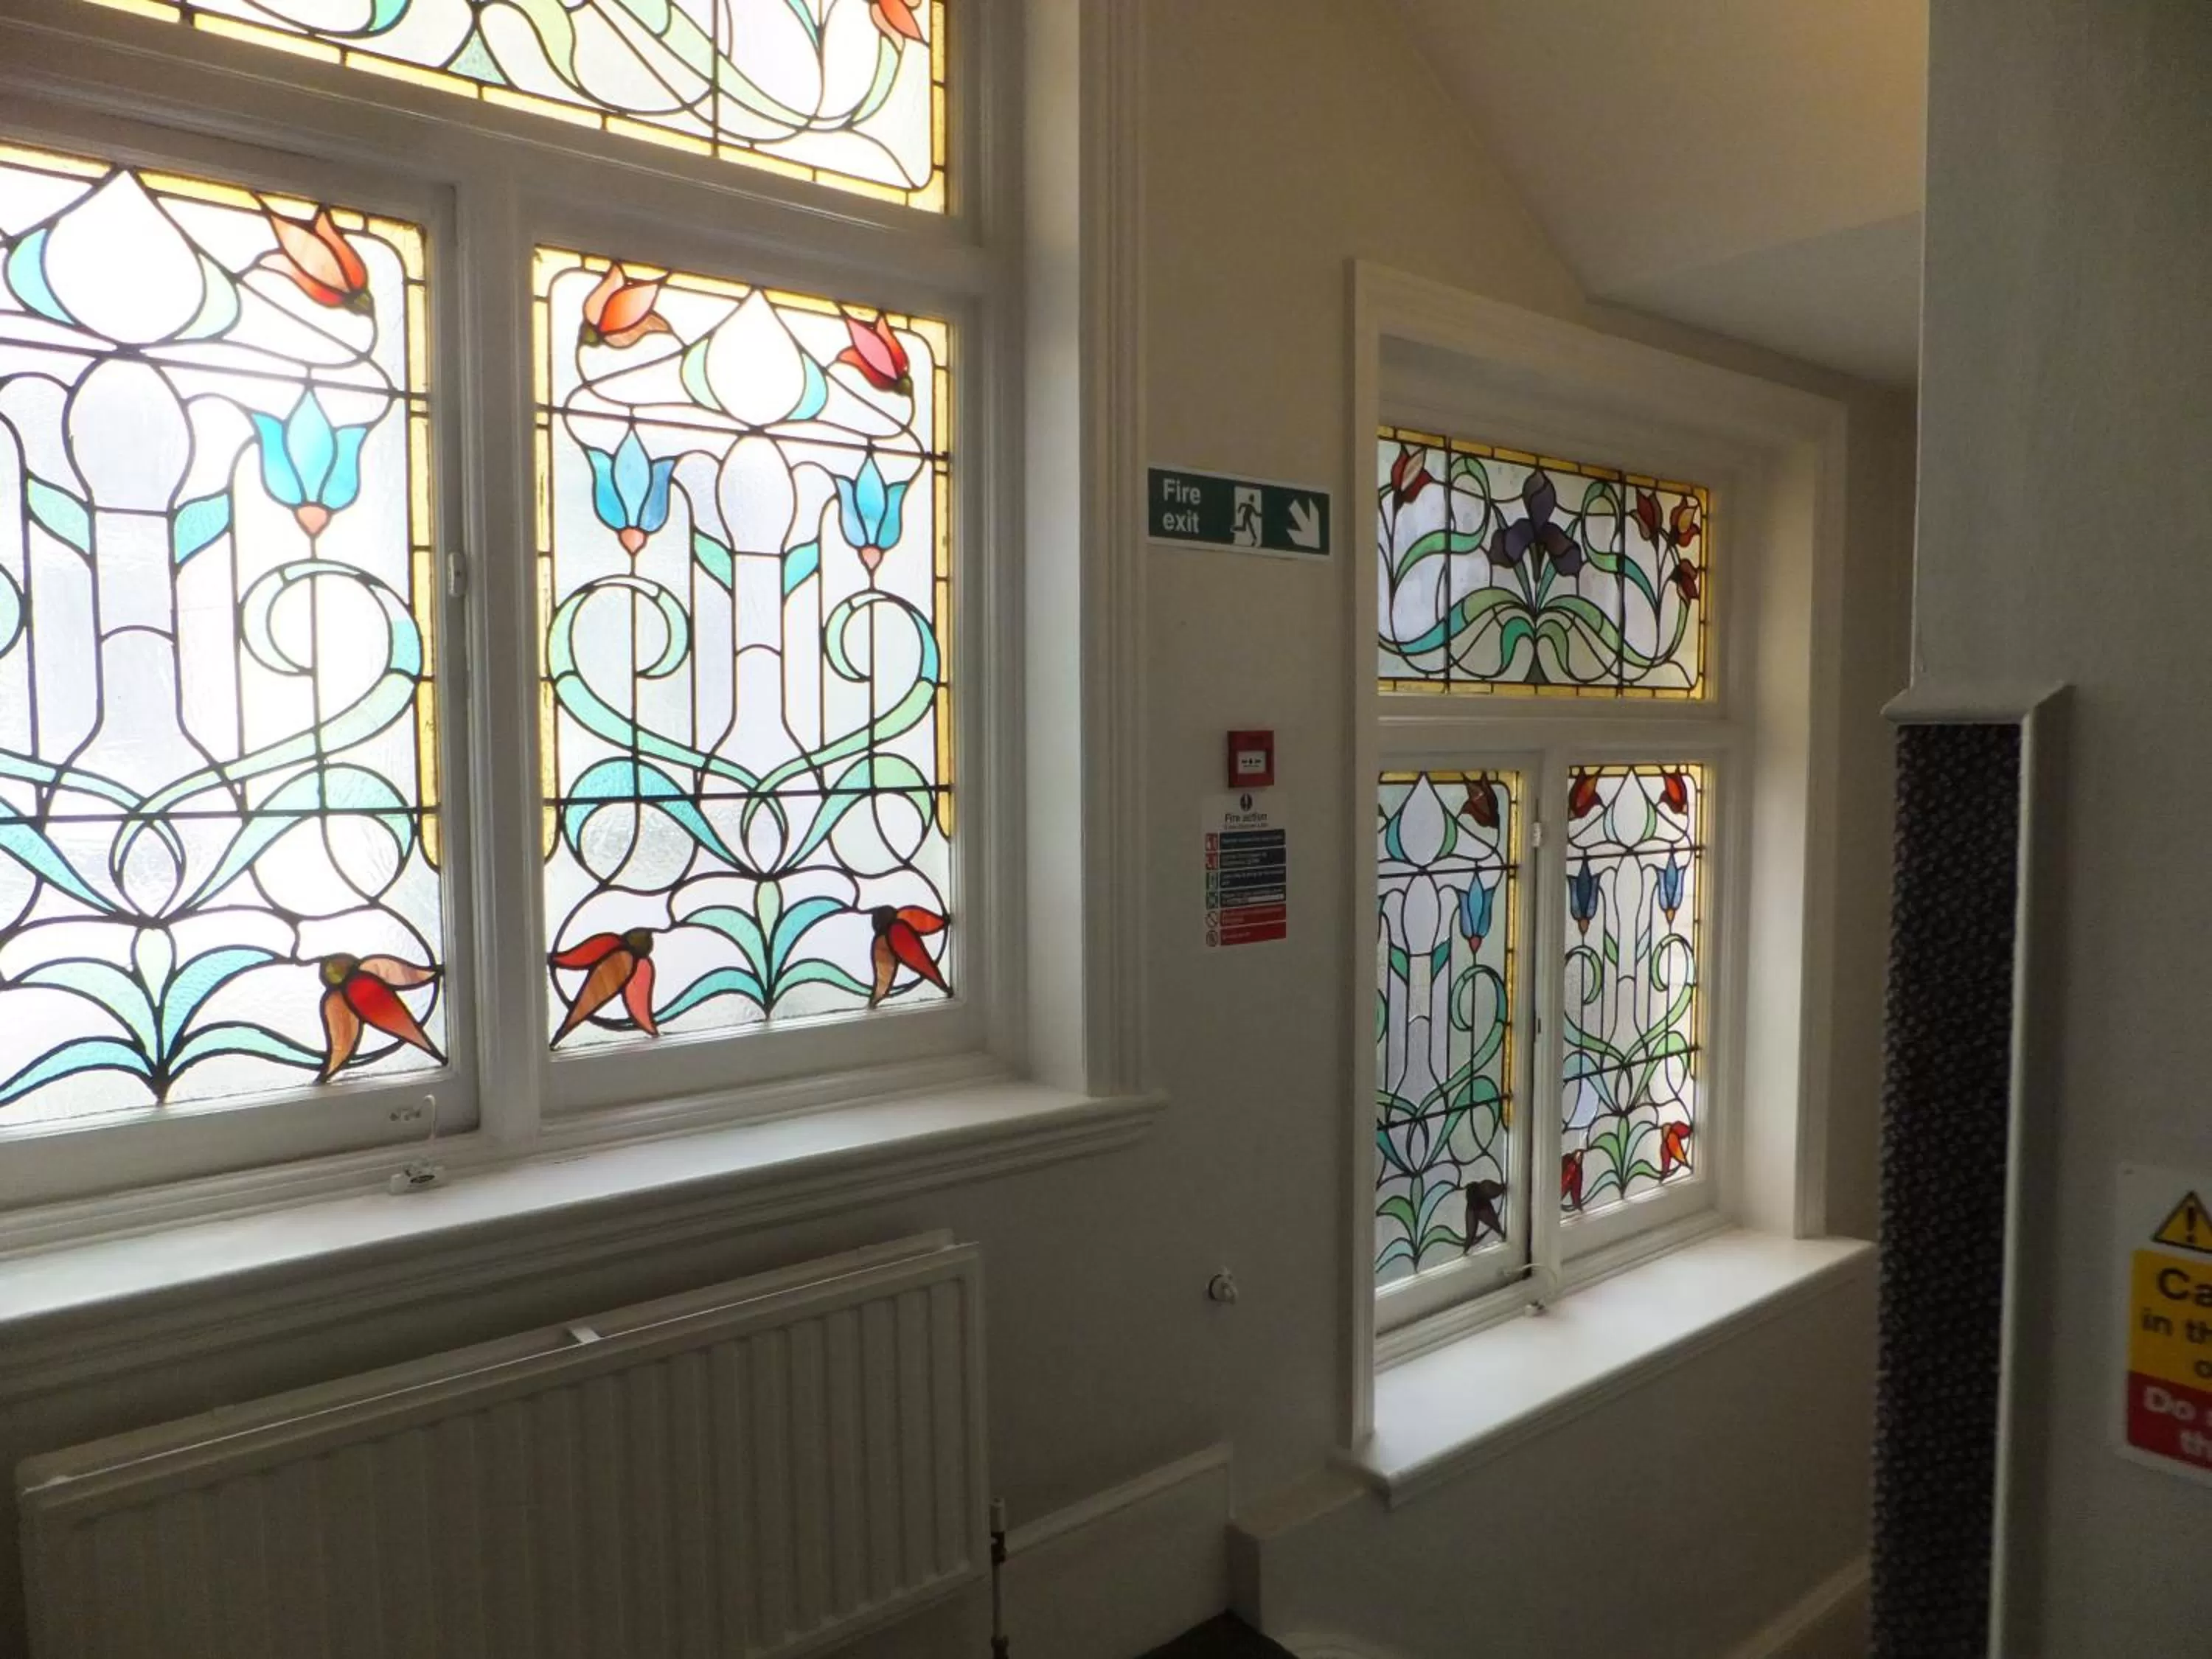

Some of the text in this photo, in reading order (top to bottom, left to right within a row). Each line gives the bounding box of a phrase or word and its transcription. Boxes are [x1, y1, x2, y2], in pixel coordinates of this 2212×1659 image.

[1163, 478, 1201, 505] Fire
[1162, 509, 1200, 534] exit
[1225, 813, 1240, 823] Fire
[2143, 1307, 2173, 1337] in
[2143, 1385, 2197, 1420] Do
